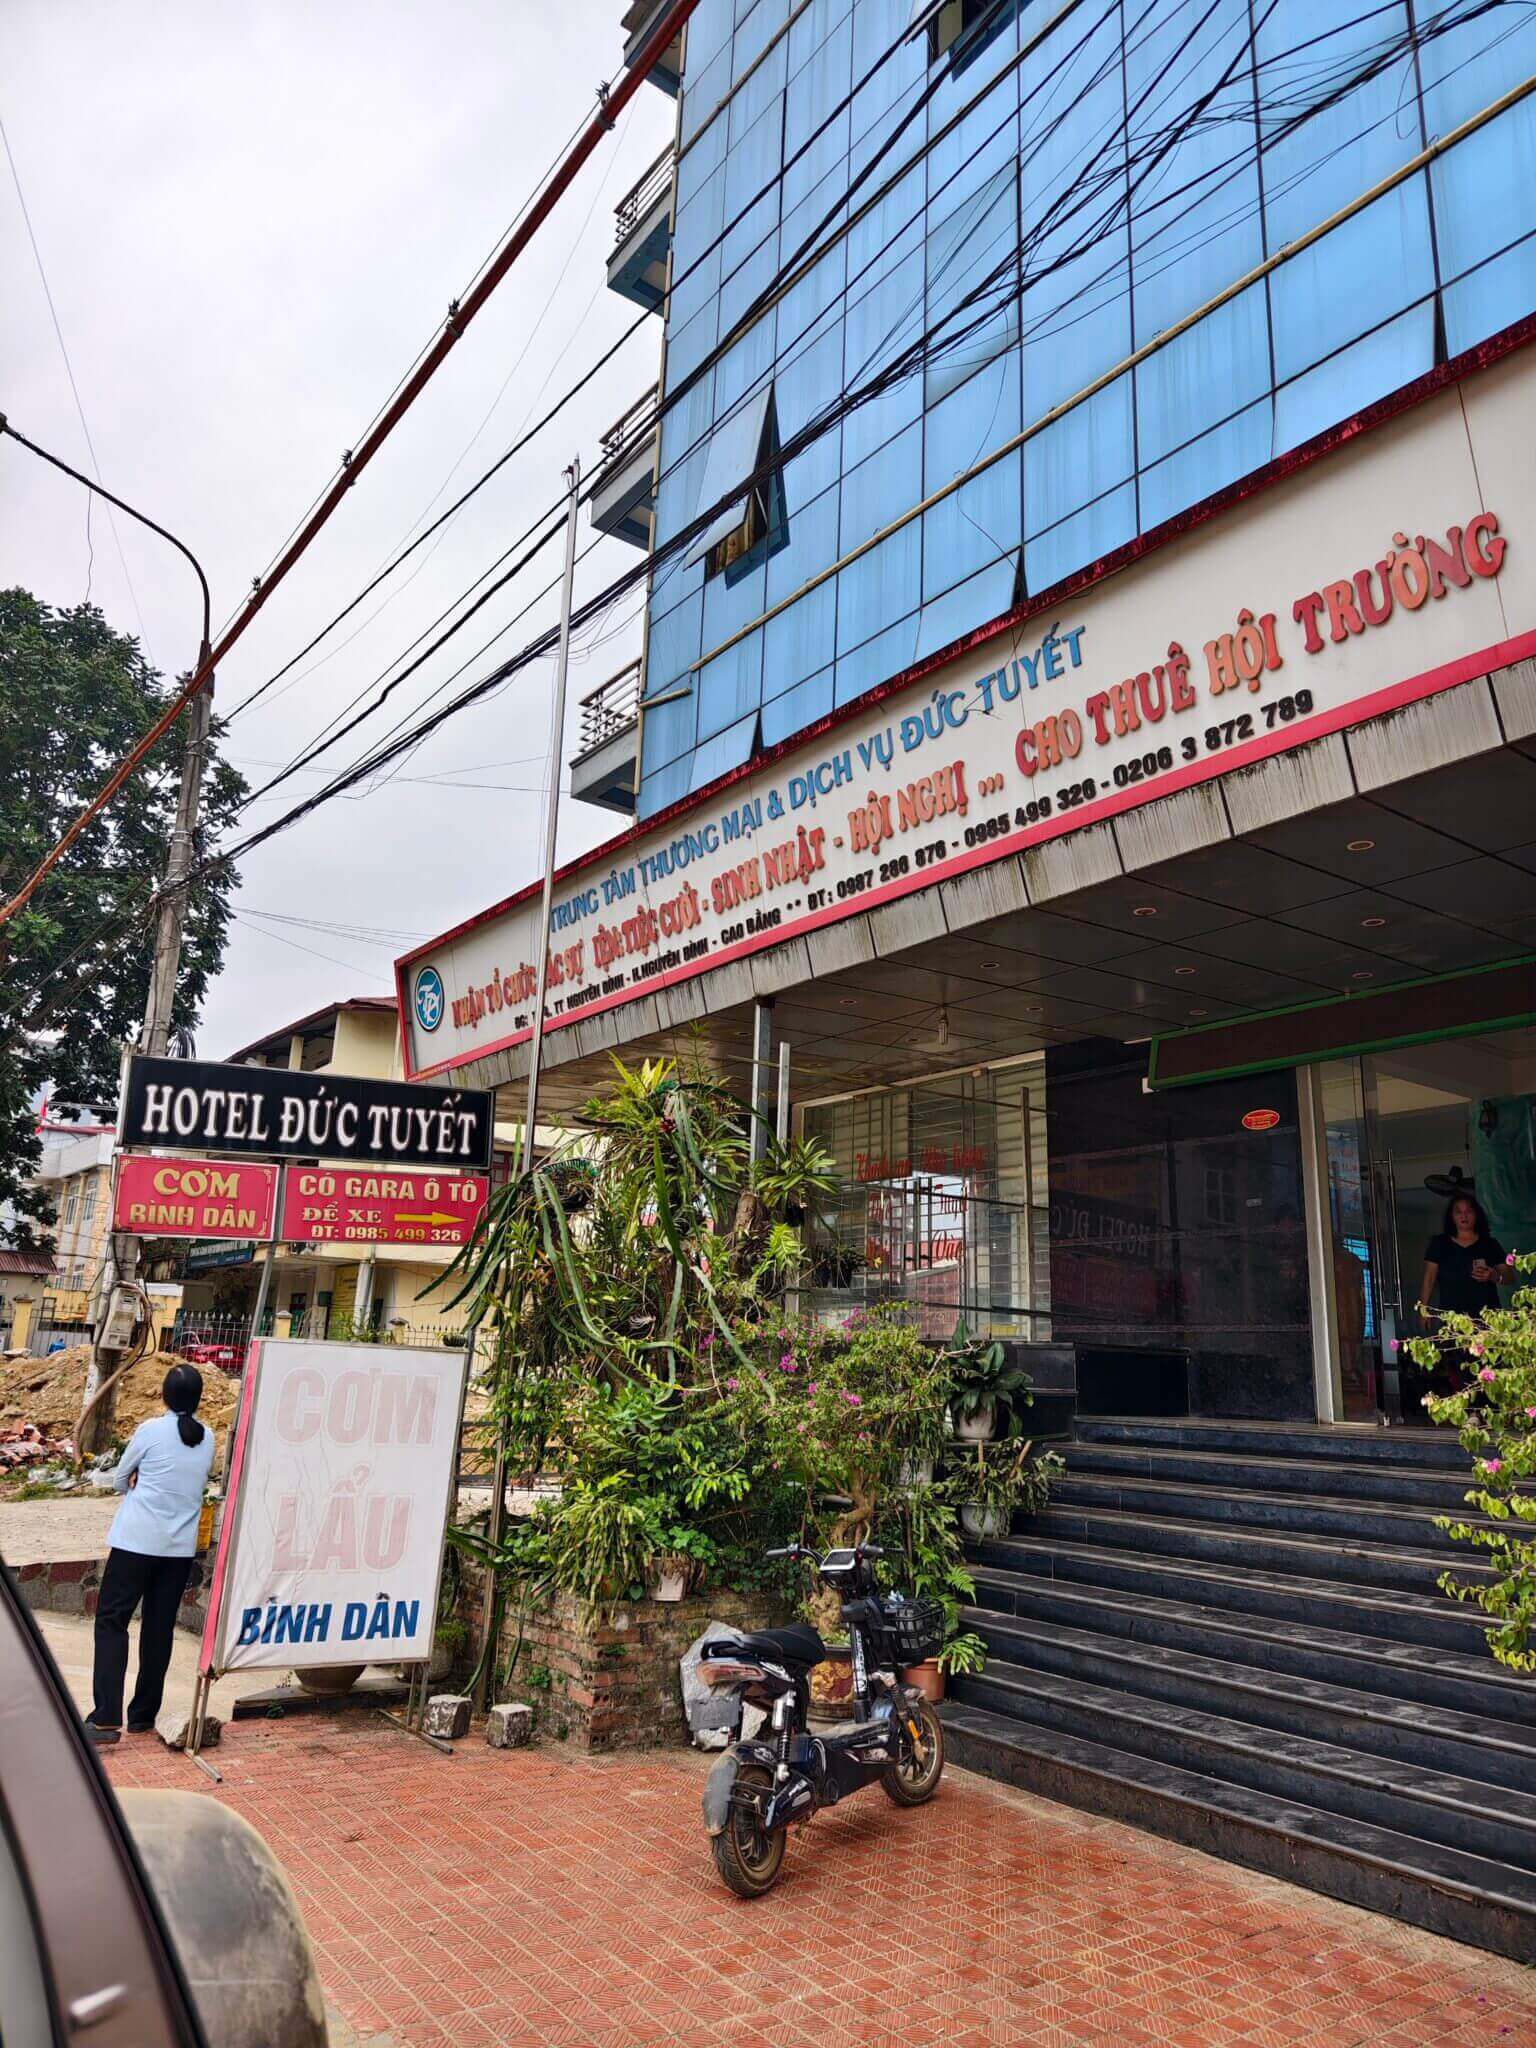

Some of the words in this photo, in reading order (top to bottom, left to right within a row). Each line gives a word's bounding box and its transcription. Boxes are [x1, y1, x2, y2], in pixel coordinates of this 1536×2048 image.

[452, 986, 486, 1029] NHẬN
[486, 968, 503, 1013] TỔ
[503, 962, 536, 1006] CHỨC
[564, 938, 584, 985] SỰ
[621, 905, 658, 956] TIỆC
[711, 858, 762, 915] SINH
[763, 825, 826, 889] NHẬT
[848, 790, 893, 855] HỘI
[897, 760, 968, 832] NGHỊ
[1015, 708, 1082, 777] CHO
[1086, 641, 1196, 745] THUÊ
[1203, 608, 1283, 695] HỘI
[1293, 512, 1507, 655] TRƯỜNG
[550, 888, 599, 933] TRUNG
[600, 869, 636, 906] TÂM
[637, 823, 719, 888] THƯƠNG
[722, 797, 762, 844] MẠI
[767, 790, 785, 820] &
[788, 750, 852, 809] DỊCH
[857, 727, 893, 771] VỤ
[900, 689, 968, 752] ĐỨC
[975, 622, 1085, 711] TUYẾT
[721, 923, 744, 944] CAO
[836, 869, 873, 898] 0987
[964, 813, 1010, 849] 0985
[1015, 796, 1052, 827] 499
[1056, 777, 1096, 810] 326
[1113, 746, 1173, 787] 0206
[1182, 737, 1197, 760] 3
[1205, 714, 1254, 750] 872
[1261, 689, 1314, 728] 789
[141, 1085, 270, 1142] HOTEL
[279, 1086, 359, 1147] ĐỨC
[368, 1093, 477, 1155] TUYẾT
[129, 1199, 194, 1228] BÌNH
[202, 1204, 256, 1229] DÂN
[153, 1167, 240, 1200] CƠM
[299, 1173, 335, 1196] CÓ
[345, 1178, 415, 1200] GARA
[424, 1178, 440, 1201] Ô
[448, 1180, 478, 1203] TÔ
[301, 1200, 339, 1222] ĐỂ
[346, 1209, 382, 1224] XE
[311, 1224, 339, 1238] ĐT:
[345, 1225, 388, 1239] 0985
[394, 1228, 426, 1241] 499
[430, 1229, 461, 1242] 326
[276, 1367, 440, 1446] CƠM
[271, 1463, 412, 1573] LẨU
[236, 1592, 332, 1646] BÌNH
[341, 1592, 420, 1641] DÂN
